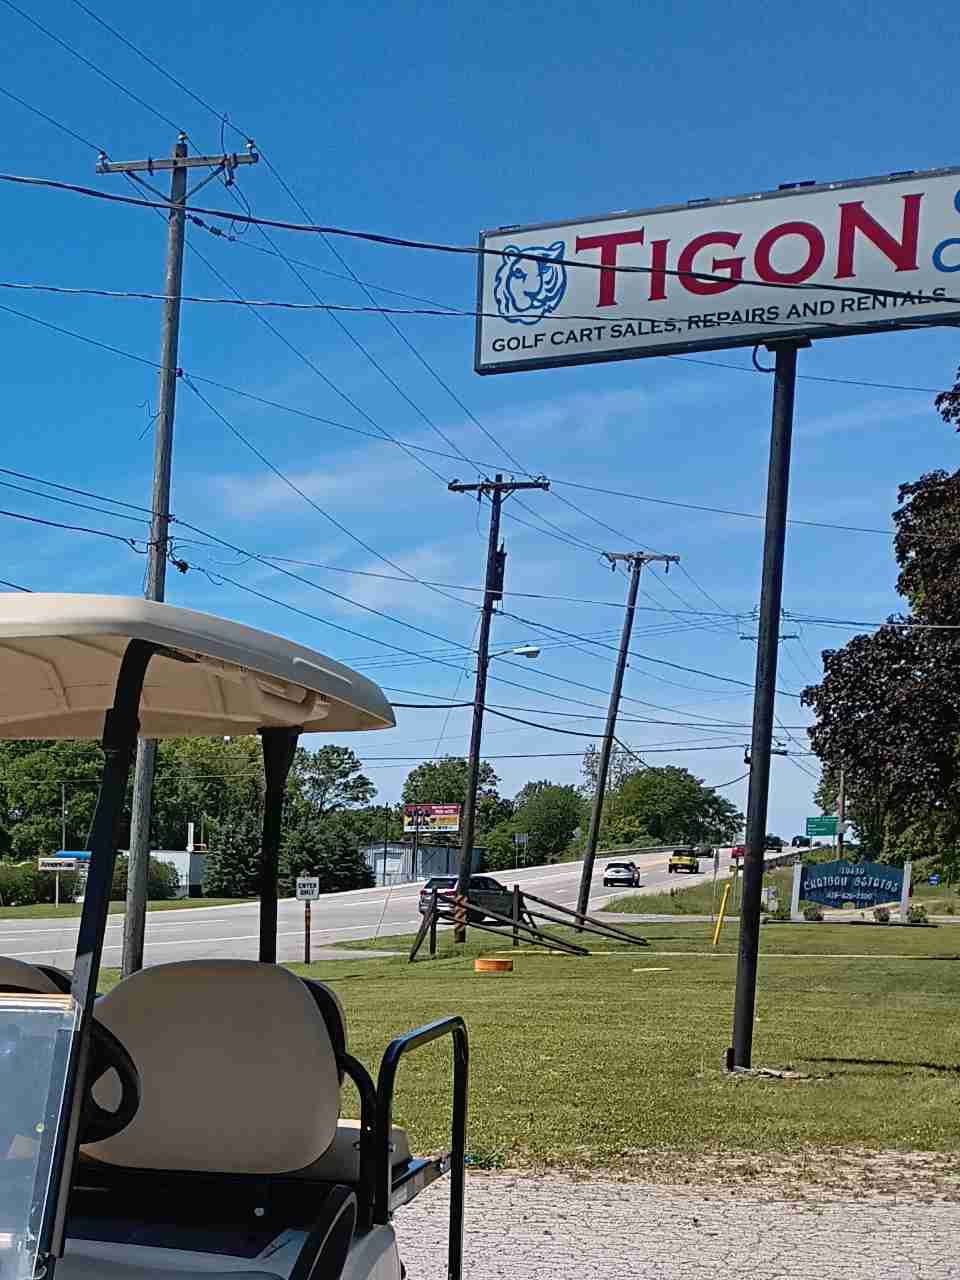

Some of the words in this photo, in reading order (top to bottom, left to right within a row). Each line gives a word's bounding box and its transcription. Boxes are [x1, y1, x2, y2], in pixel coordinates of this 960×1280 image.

[575, 192, 925, 308] TIGON
[492, 333, 546, 352] GOLF
[551, 326, 606, 346] CART
[610, 318, 682, 338] SALES,
[687, 306, 780, 331] REPAIRS
[786, 300, 835, 319] AND
[840, 288, 946, 313] RENTALS
